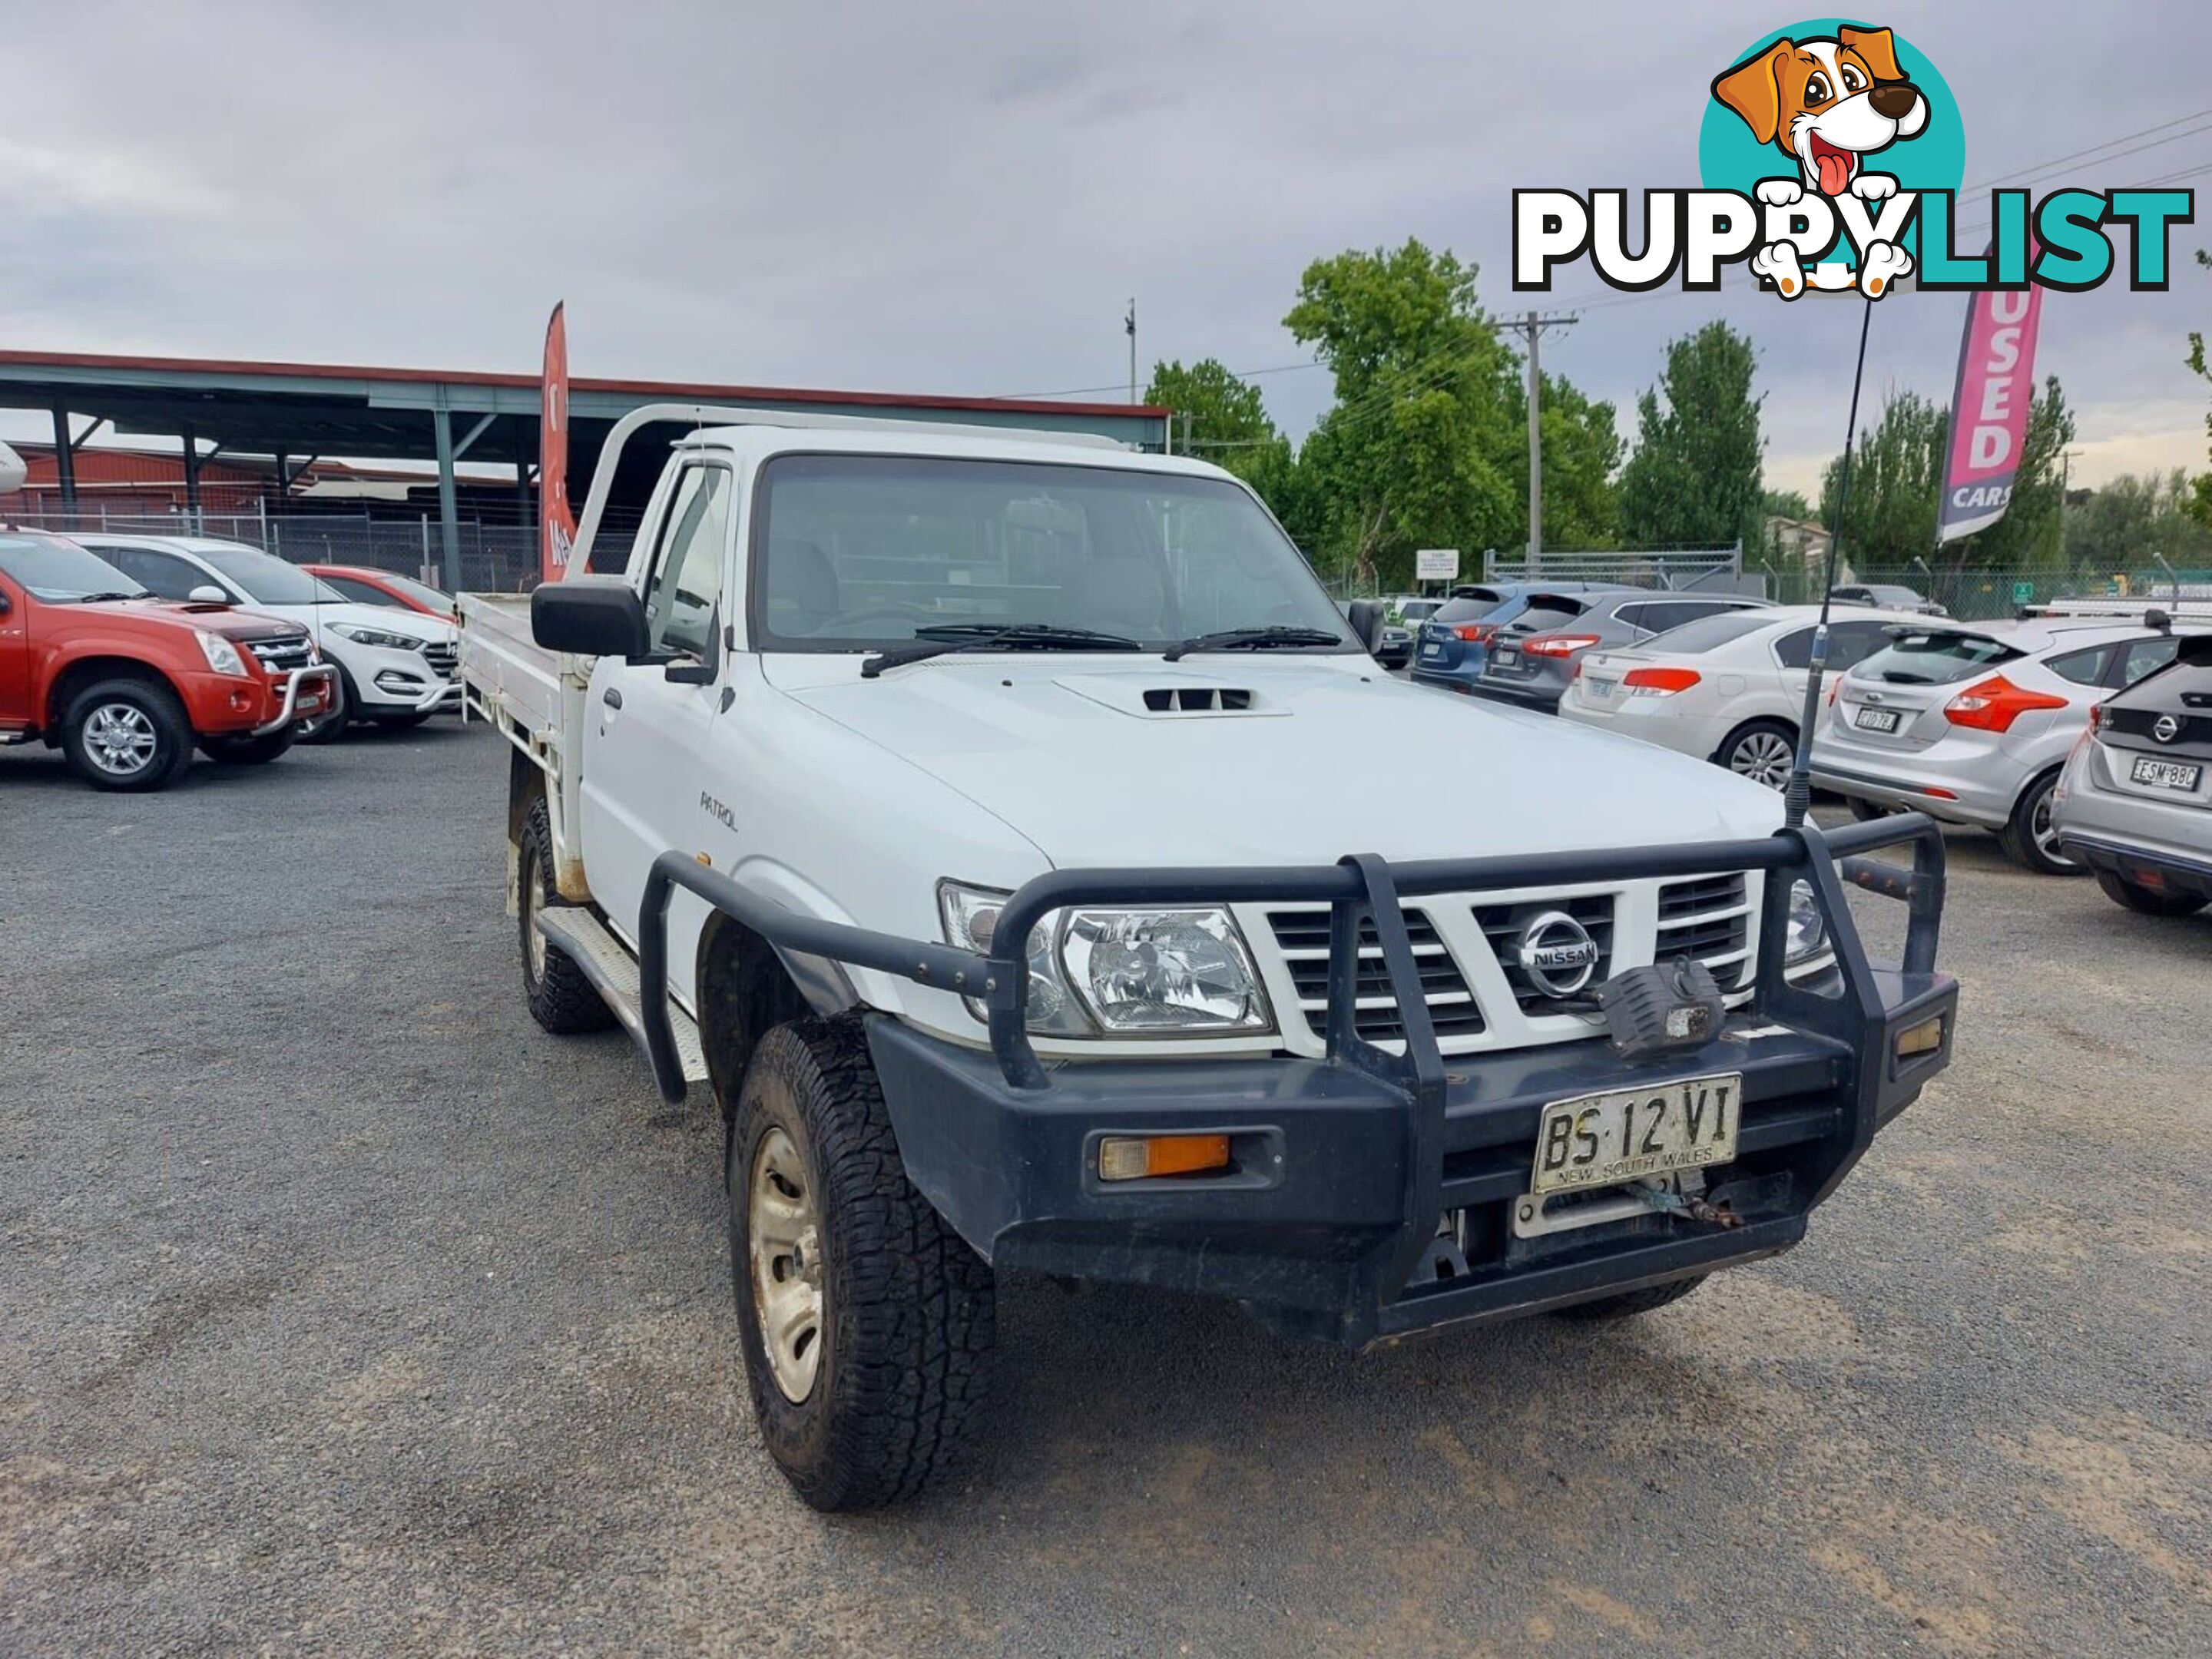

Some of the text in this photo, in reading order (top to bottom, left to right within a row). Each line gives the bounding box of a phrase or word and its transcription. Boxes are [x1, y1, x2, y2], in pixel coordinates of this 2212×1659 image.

[1969, 290, 2029, 469] USED
[700, 790, 738, 833] PATROL
[1534, 943, 1594, 965] NISSAN
[1558, 1147, 1713, 1184] NEW SOUTH WALES
